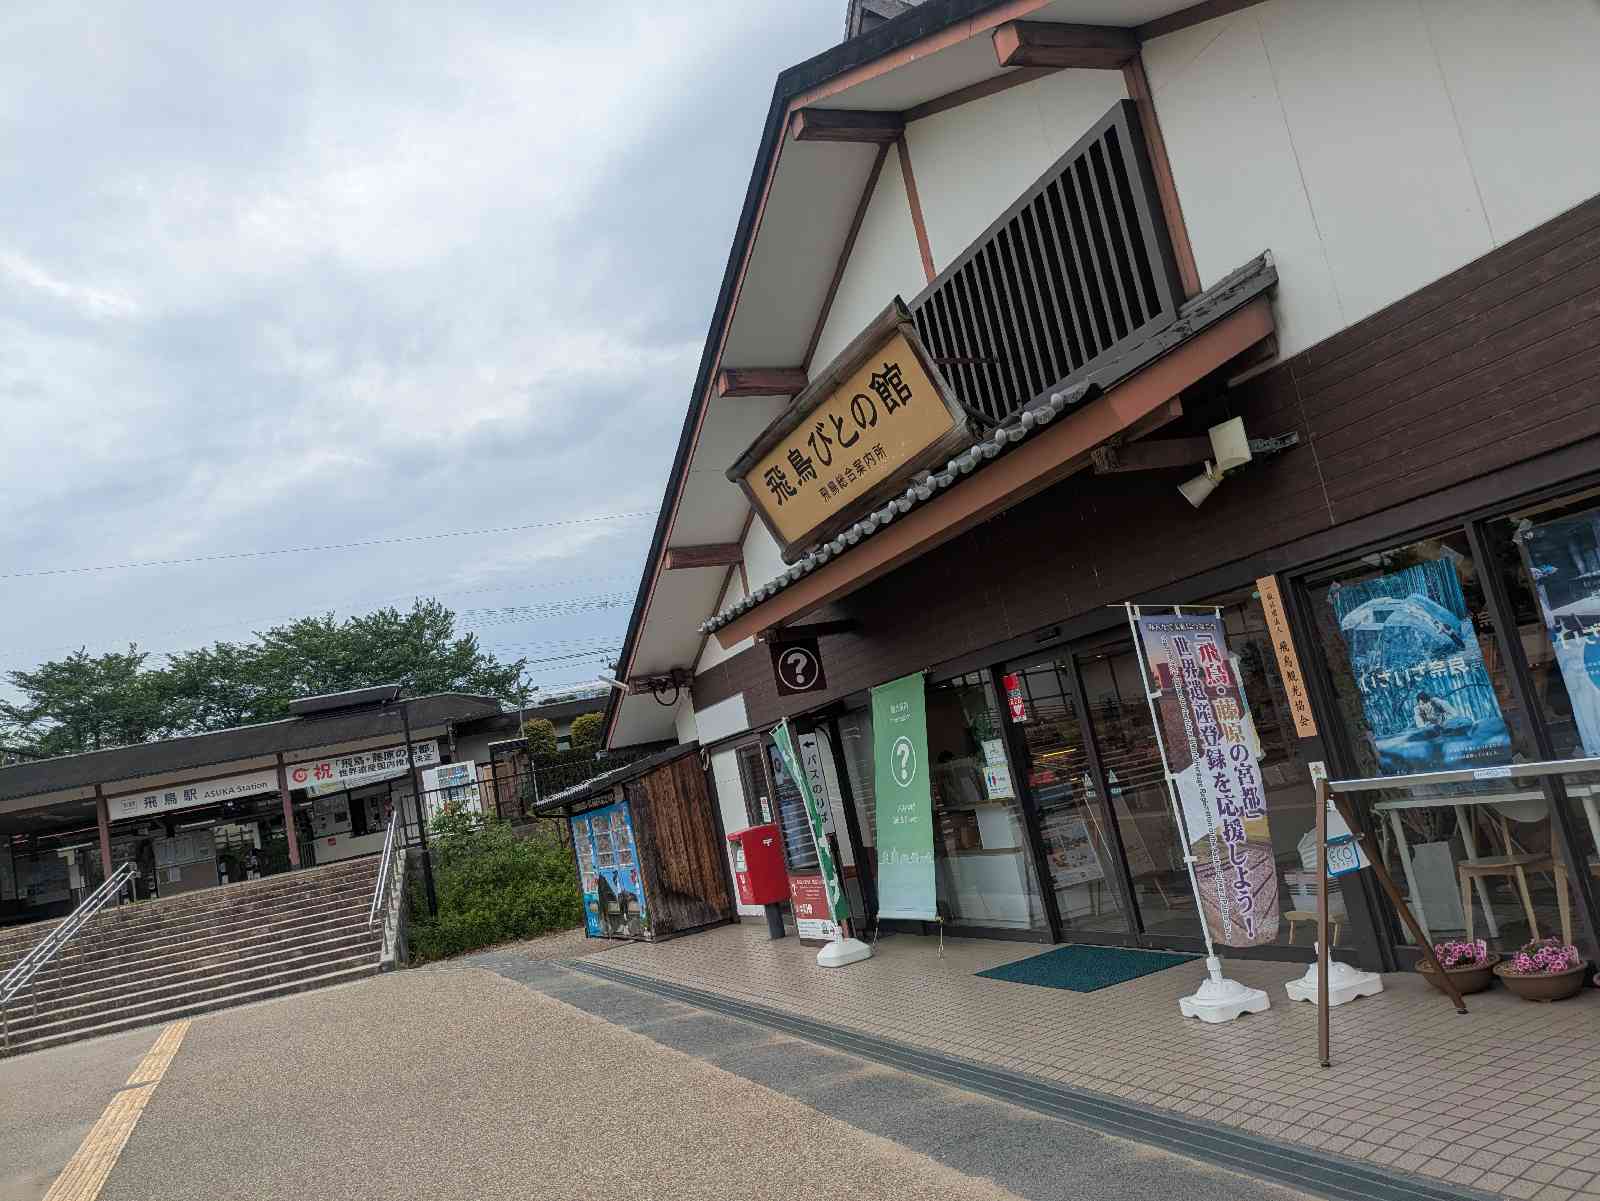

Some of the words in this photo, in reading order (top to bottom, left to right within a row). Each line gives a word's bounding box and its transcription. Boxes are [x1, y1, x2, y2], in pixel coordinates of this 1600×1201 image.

[764, 362, 912, 506] 飛鳥びとの館
[818, 442, 888, 505] 飛鳥総合案内所
[143, 788, 198, 809] 飛鳥駅
[204, 787, 235, 799] ASUKA
[236, 782, 268, 793] Station
[314, 763, 333, 781] 祝
[808, 754, 827, 823] バスのりば
[1173, 636, 1255, 938] 世界遺産登録を応援しよう！
